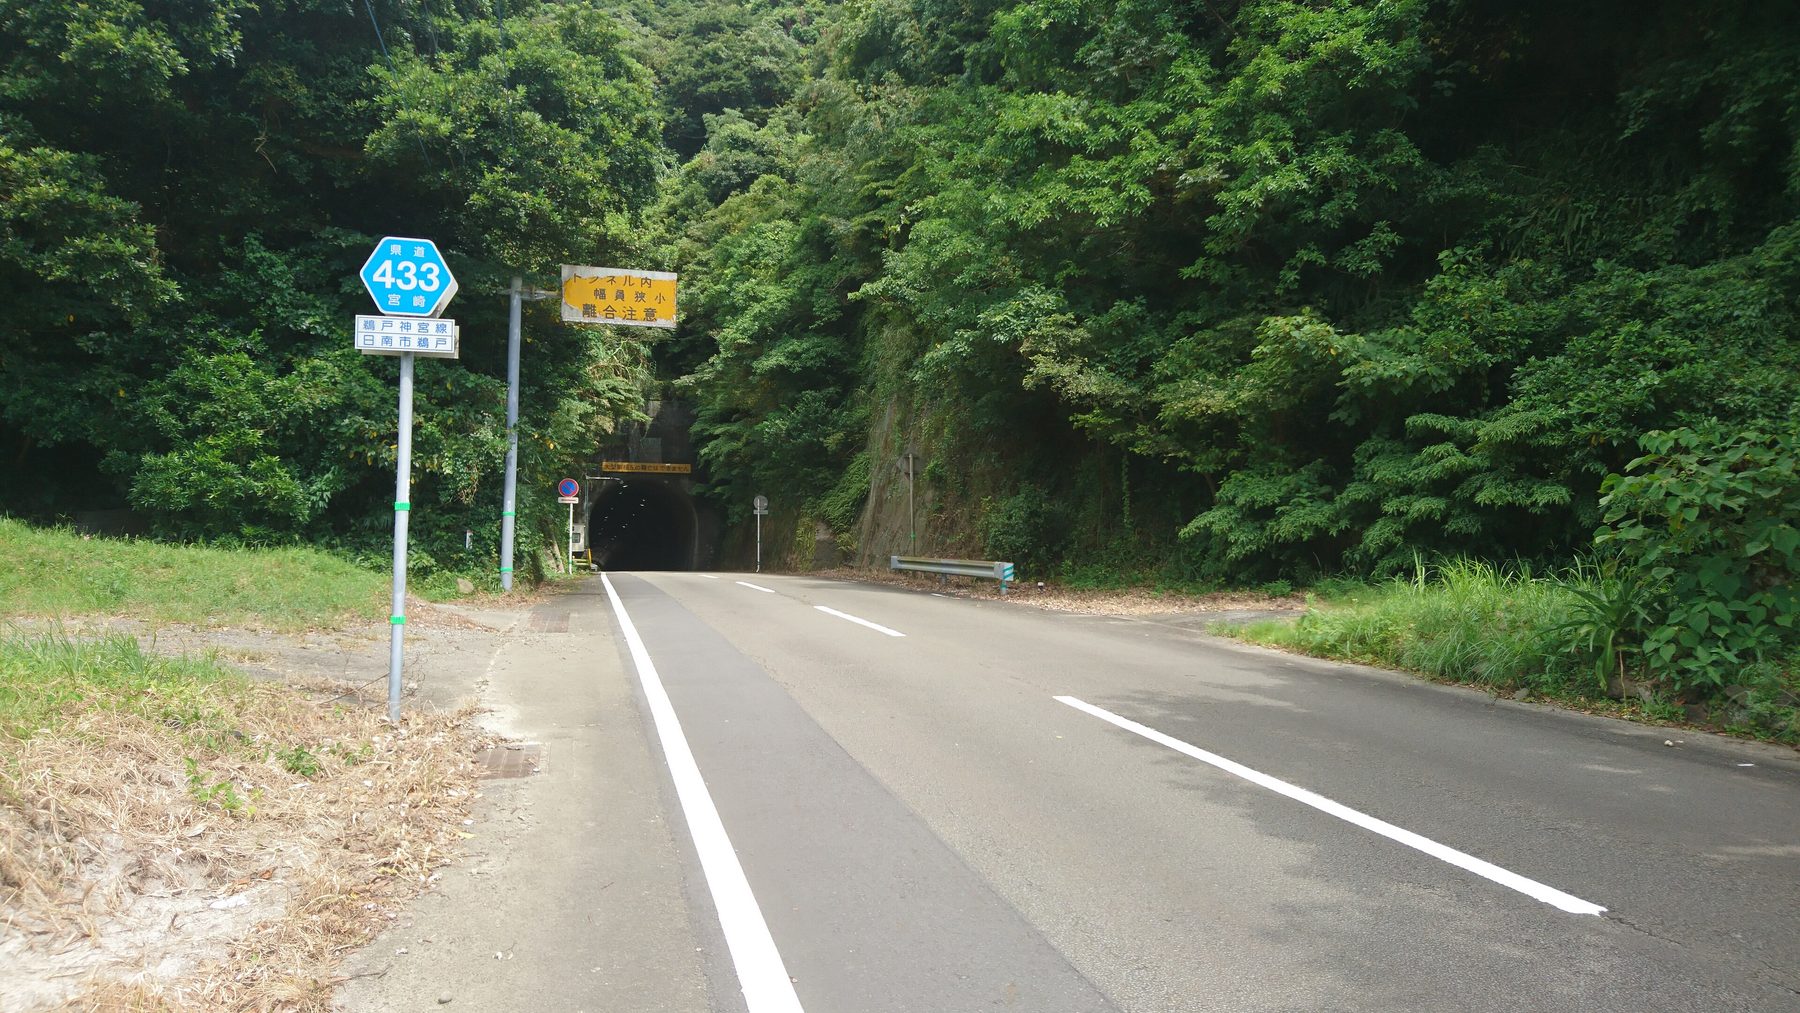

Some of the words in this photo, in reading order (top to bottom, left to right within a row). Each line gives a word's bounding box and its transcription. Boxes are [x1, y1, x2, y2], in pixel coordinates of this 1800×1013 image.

[390, 244, 425, 258] 県道
[373, 259, 440, 292] 433
[388, 294, 426, 308] 宮崎
[593, 288, 666, 305] 幅員狭小
[582, 303, 657, 322] 離合注意
